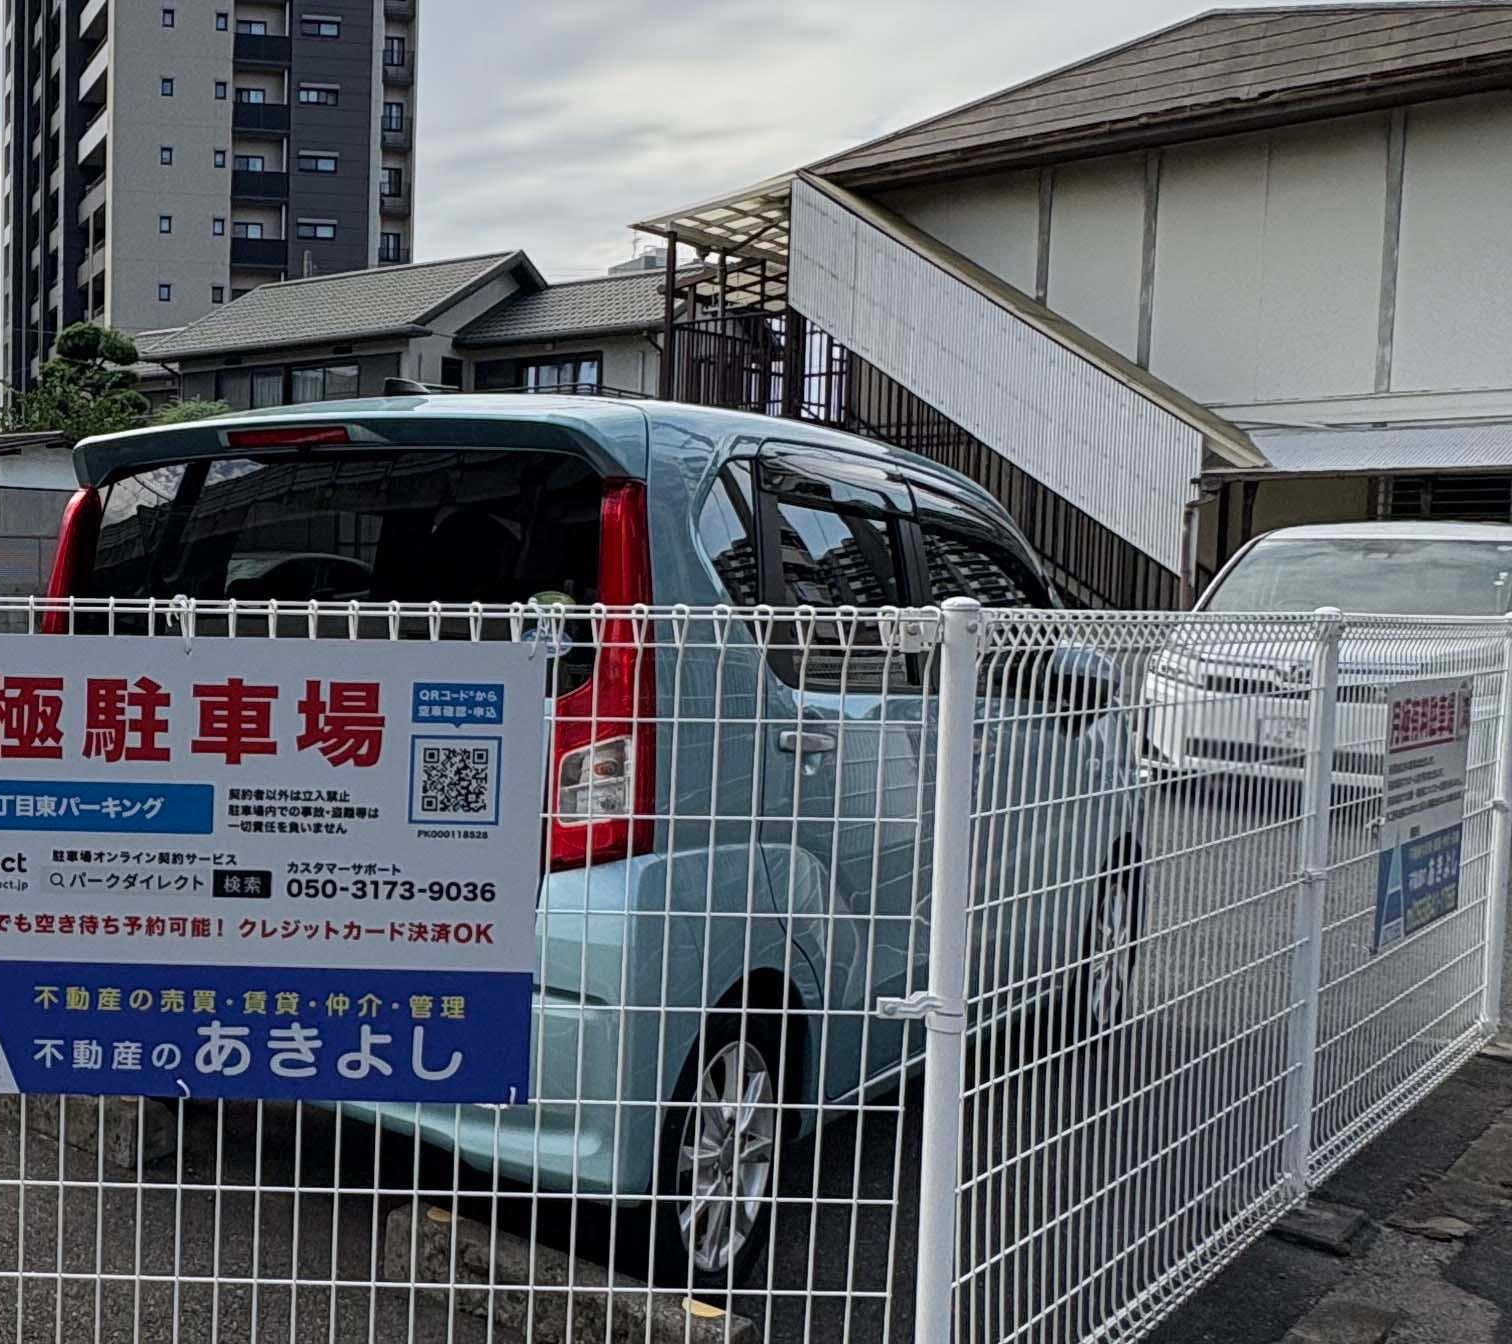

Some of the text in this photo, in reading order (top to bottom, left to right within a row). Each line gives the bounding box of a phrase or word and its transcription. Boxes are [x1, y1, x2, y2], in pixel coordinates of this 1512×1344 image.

[228, 788, 351, 803] 契約者以外は立入禁止
[227, 821, 348, 835] 一切責任を負いません
[52, 849, 238, 866] 駐車場オンライン契約サービス
[286, 862, 402, 876] カスタマーサポート
[68, 872, 262, 894] パークダイレクト 検索
[286, 878, 497, 902] 050-3173-9036
[238, 918, 495, 944] クレジットカード決済OK
[33, 985, 468, 1019] 不動産の売買・賃貸・仲介・管理
